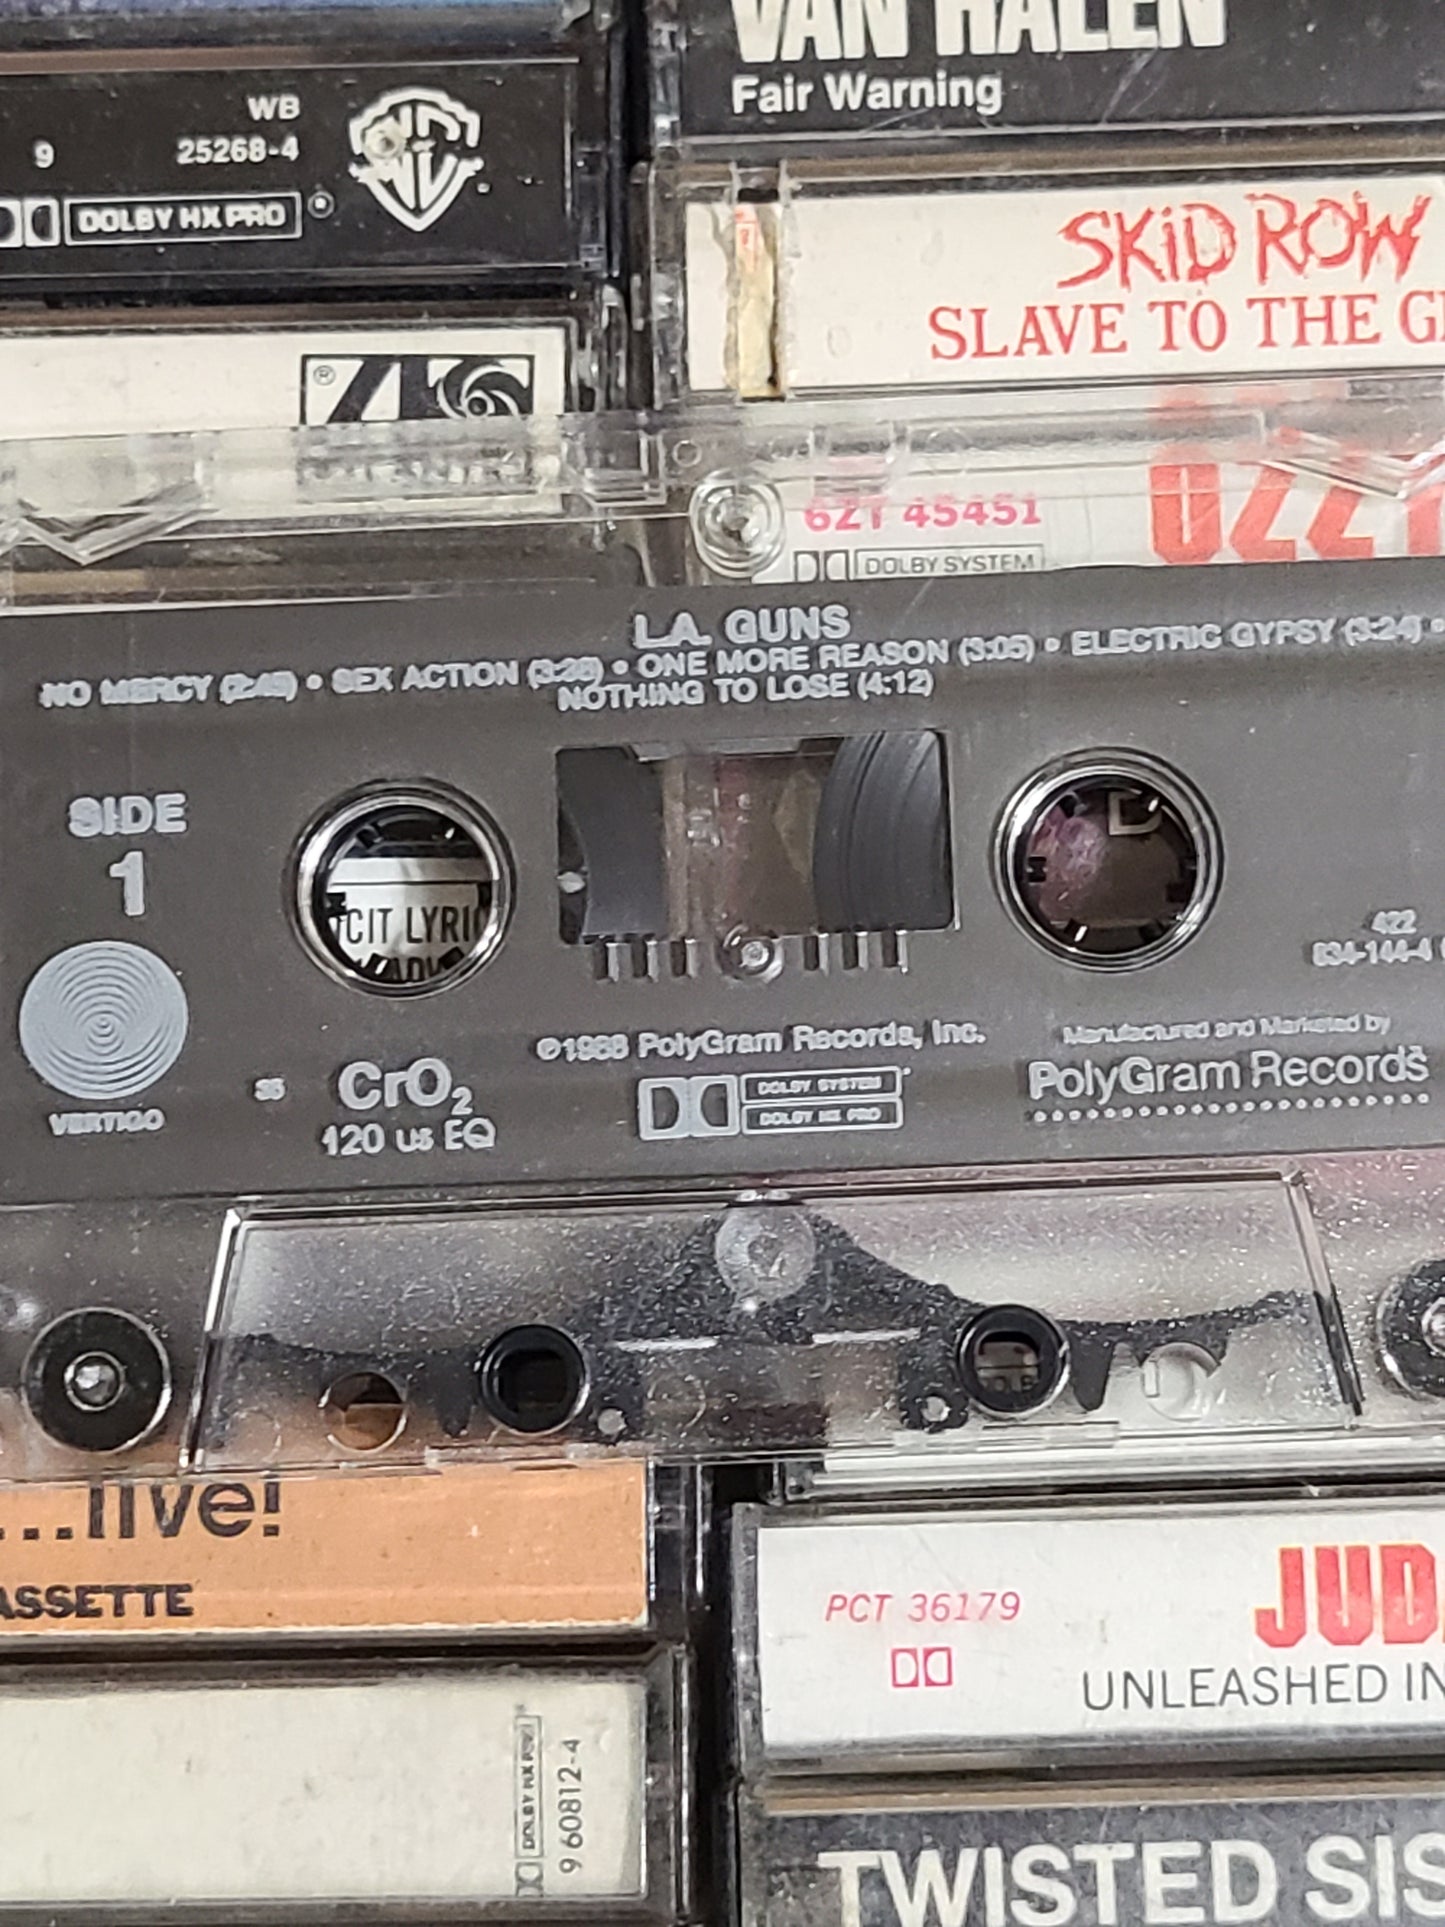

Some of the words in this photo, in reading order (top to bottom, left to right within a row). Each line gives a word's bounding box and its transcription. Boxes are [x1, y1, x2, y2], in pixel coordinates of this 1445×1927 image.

[730, 0, 908, 62] VAN
[935, 0, 1227, 55] HALEN
[249, 96, 301, 119] WB
[731, 75, 811, 114] Fair
[825, 69, 1003, 116] Warning
[34, 142, 55, 168] 9
[176, 136, 300, 165] 25268-4
[78, 206, 173, 234] DOLBY
[179, 207, 221, 230] HX
[226, 203, 286, 228] PRO
[1244, 190, 1433, 286] ROW
[930, 303, 1128, 360] SLAVE
[1148, 299, 1228, 353] TO
[1247, 294, 1381, 348] THE
[1399, 289, 1445, 345] G
[903, 491, 1042, 528] 45451
[865, 556, 938, 575] DOLBY
[943, 553, 1034, 573] SYSTEM
[725, 604, 851, 644] GUNS
[1070, 622, 1221, 656] ELECTRIC
[1229, 618, 1337, 649] GYPSY
[331, 666, 394, 694] SEX
[401, 659, 520, 691] ACTION
[637, 650, 708, 679] ONE
[716, 646, 810, 675] MORE
[819, 639, 949, 670] REASON
[39, 680, 91, 708] NO
[100, 675, 213, 704] MERCY
[557, 681, 704, 712] NOTHING
[713, 677, 758, 703] TO
[765, 672, 850, 701] LOSE
[857, 668, 935, 701] (4:12)
[68, 792, 188, 838] SIDE
[108, 850, 146, 917] 1
[638, 1030, 782, 1062] PolyGram
[793, 1022, 922, 1051] Records,
[932, 1019, 986, 1046] Inc.
[1062, 1021, 1210, 1046] Manufactured
[1214, 1019, 1255, 1039] and
[1260, 1014, 1361, 1037] Marketed
[1364, 1013, 1391, 1036] by
[758, 1079, 812, 1096] DOLBY
[817, 1076, 882, 1093] SYSTEM
[1028, 1055, 1241, 1106] PolyGram
[1249, 1045, 1430, 1089] Records
[49, 1108, 166, 1136] VERTIGO
[321, 1122, 386, 1156] 120
[444, 1117, 497, 1151] EQ
[759, 1109, 814, 1126] DOLBY
[825, 1593, 894, 1624] PCT
[908, 1591, 1022, 1624] 36179
[1254, 1544, 1445, 1648] JUD
[1082, 1663, 1388, 1712] UNLEASHED
[557, 1738, 584, 1849] 60812-4
[522, 1794, 536, 1850] DOLBY
[558, 1857, 583, 1874] 9
[817, 1839, 1279, 1927] TWISTED
